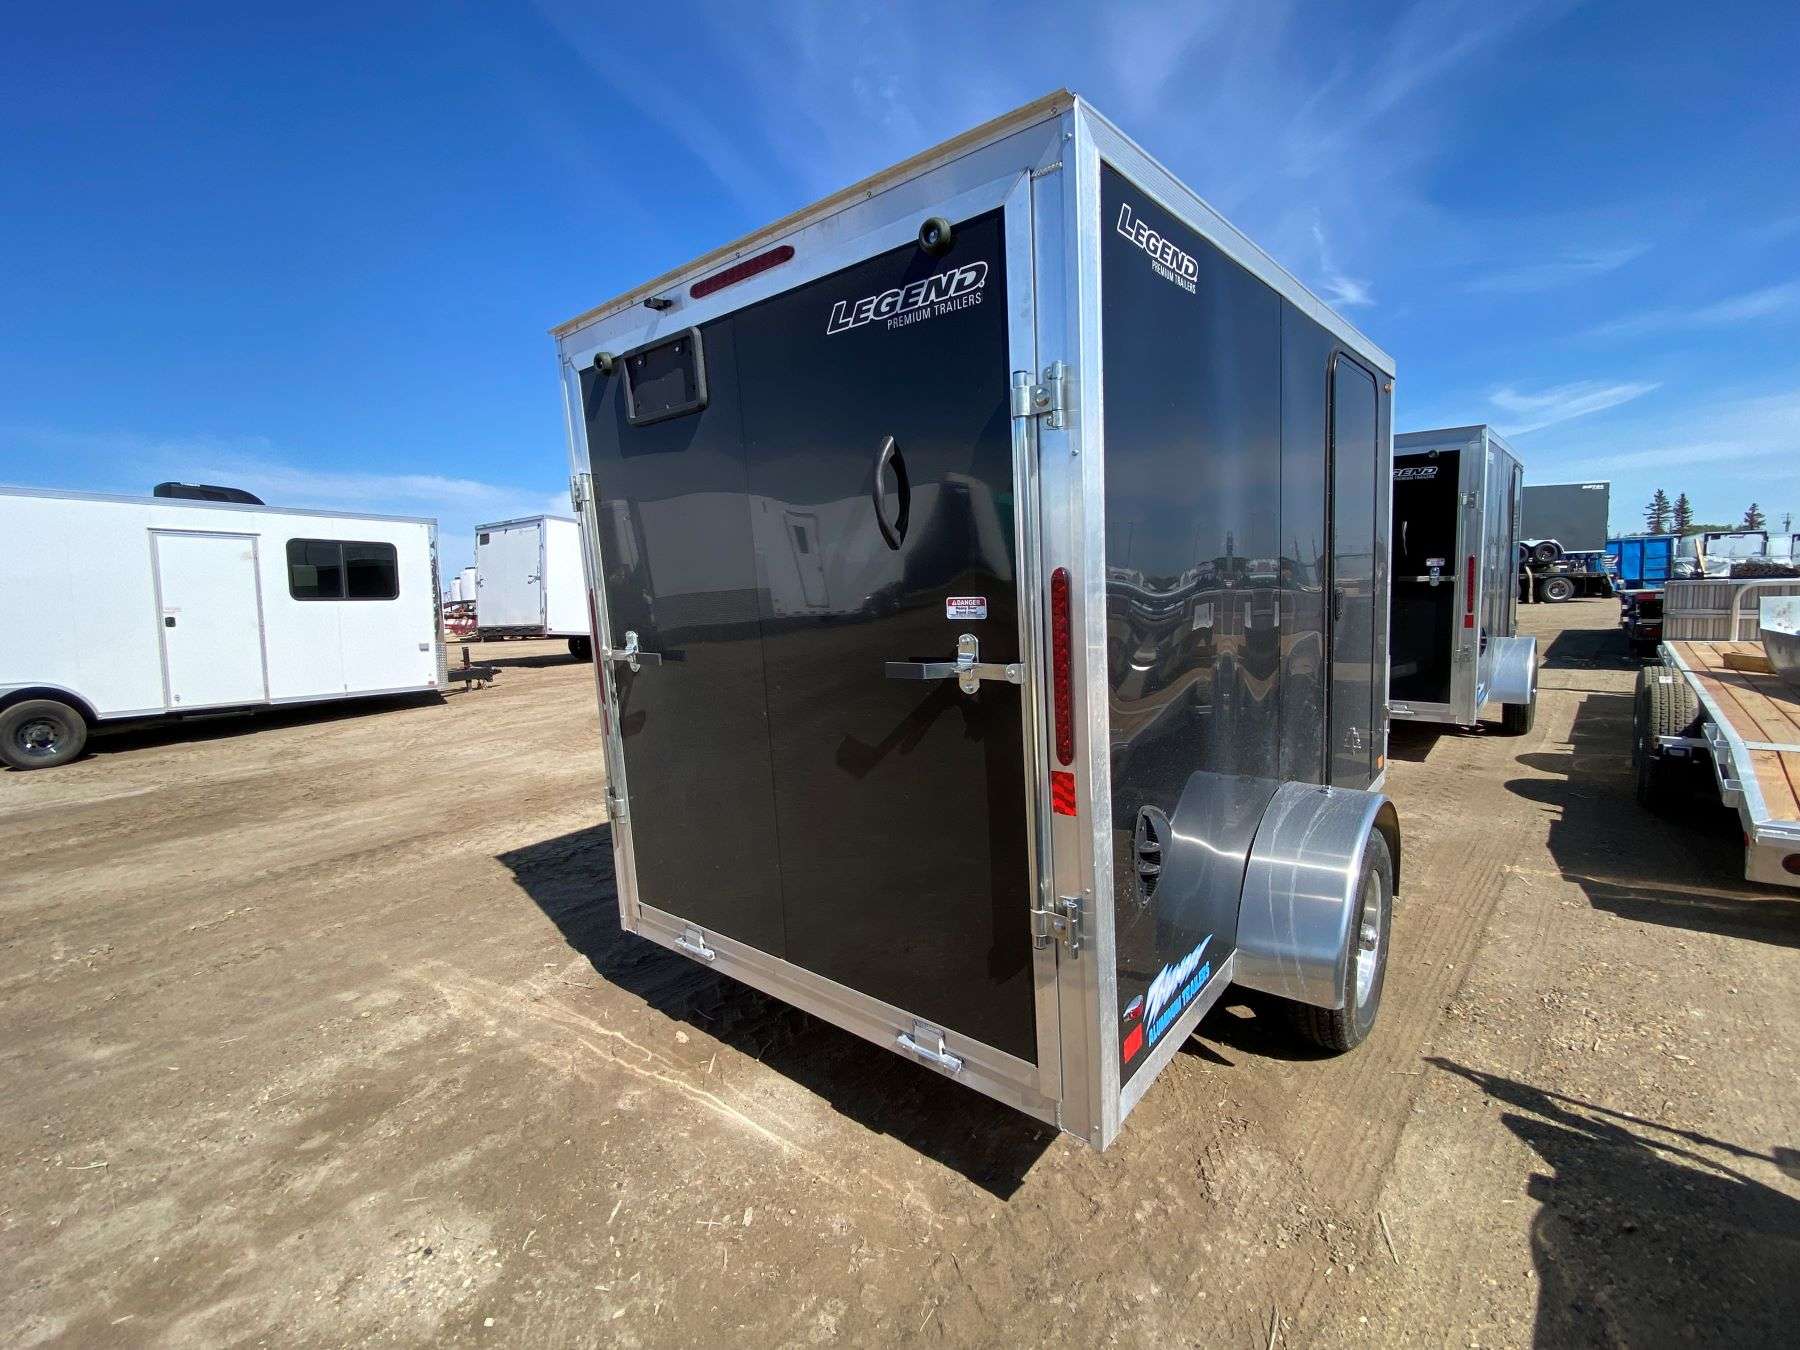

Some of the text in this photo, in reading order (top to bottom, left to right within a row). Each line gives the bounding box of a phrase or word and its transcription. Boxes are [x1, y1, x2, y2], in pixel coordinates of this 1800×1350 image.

[1117, 203, 1198, 282] LEGEND
[826, 261, 988, 335] LEGEND
[1151, 259, 1196, 295] PREMIUM TRAILERS
[887, 292, 982, 330] PREMIUM TRAILERS
